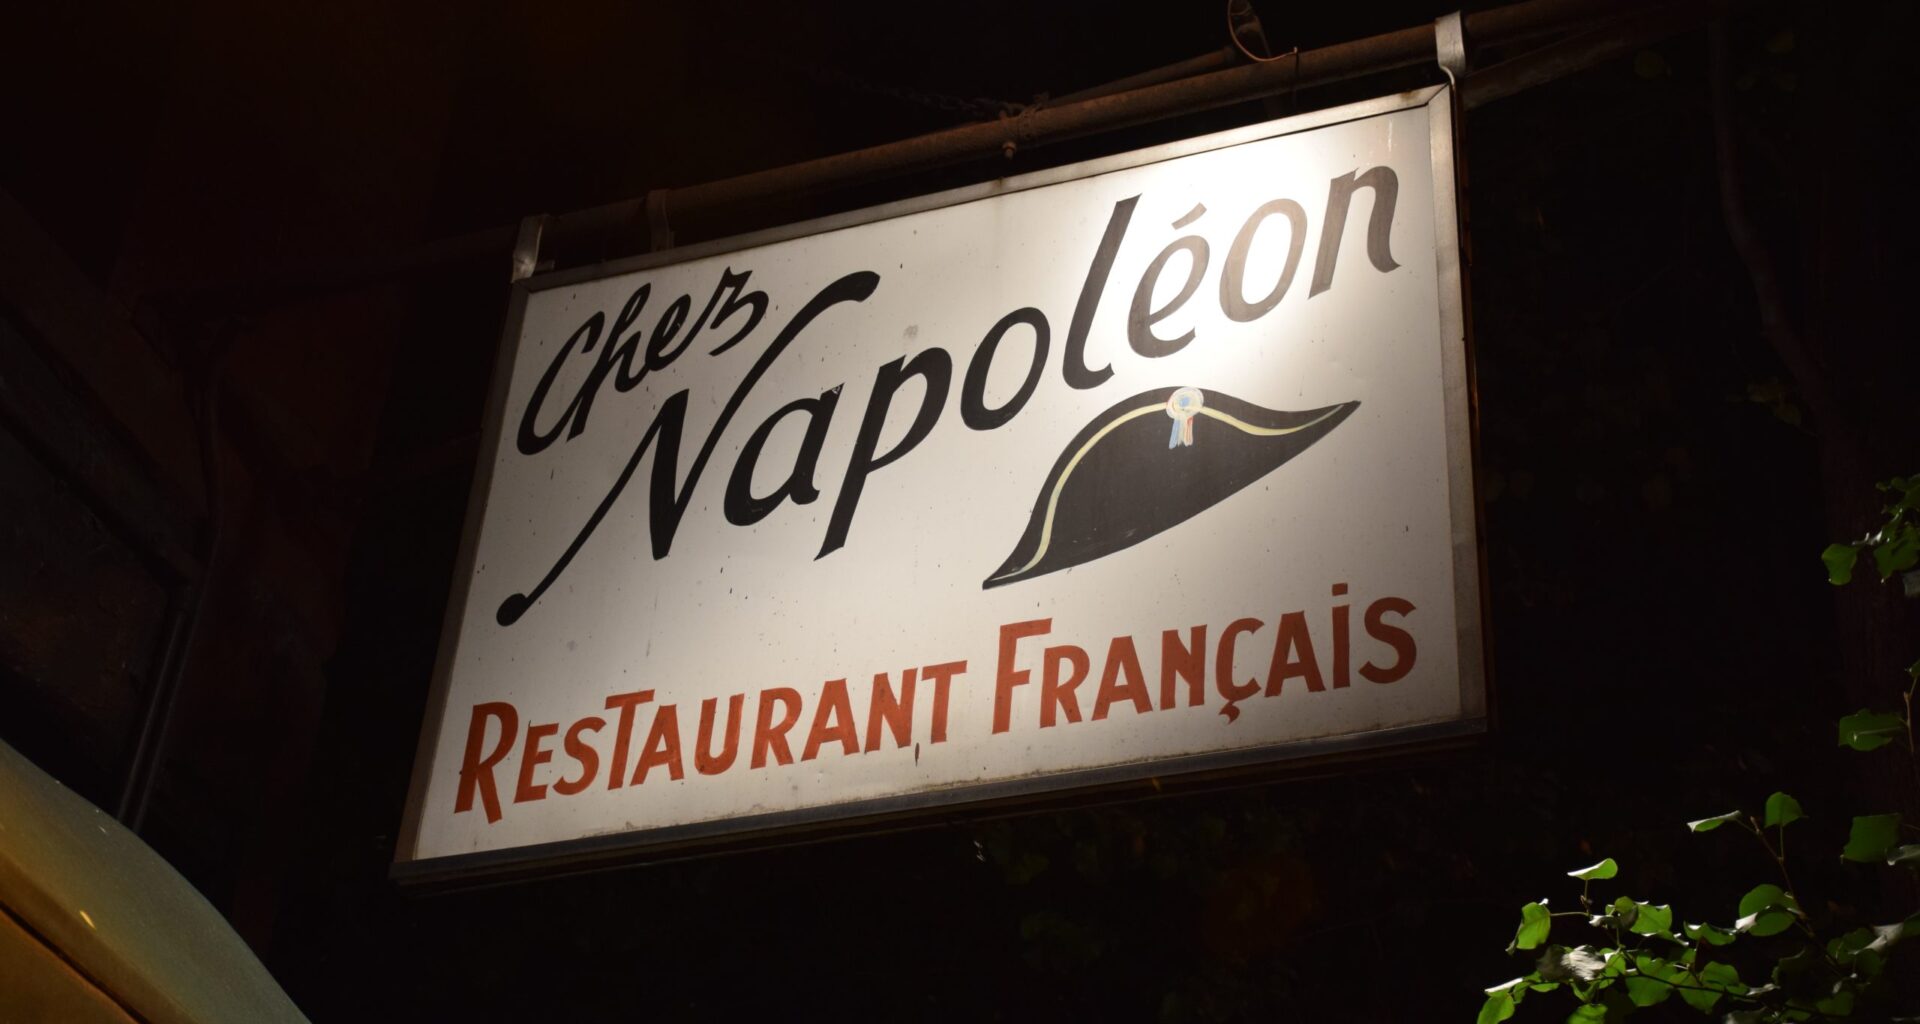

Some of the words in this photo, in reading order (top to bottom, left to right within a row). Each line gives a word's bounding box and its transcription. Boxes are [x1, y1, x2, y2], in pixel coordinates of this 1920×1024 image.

[496, 165, 1402, 627] Napoléon
[516, 266, 770, 456] Chez
[454, 660, 968, 824] RESTAURANT
